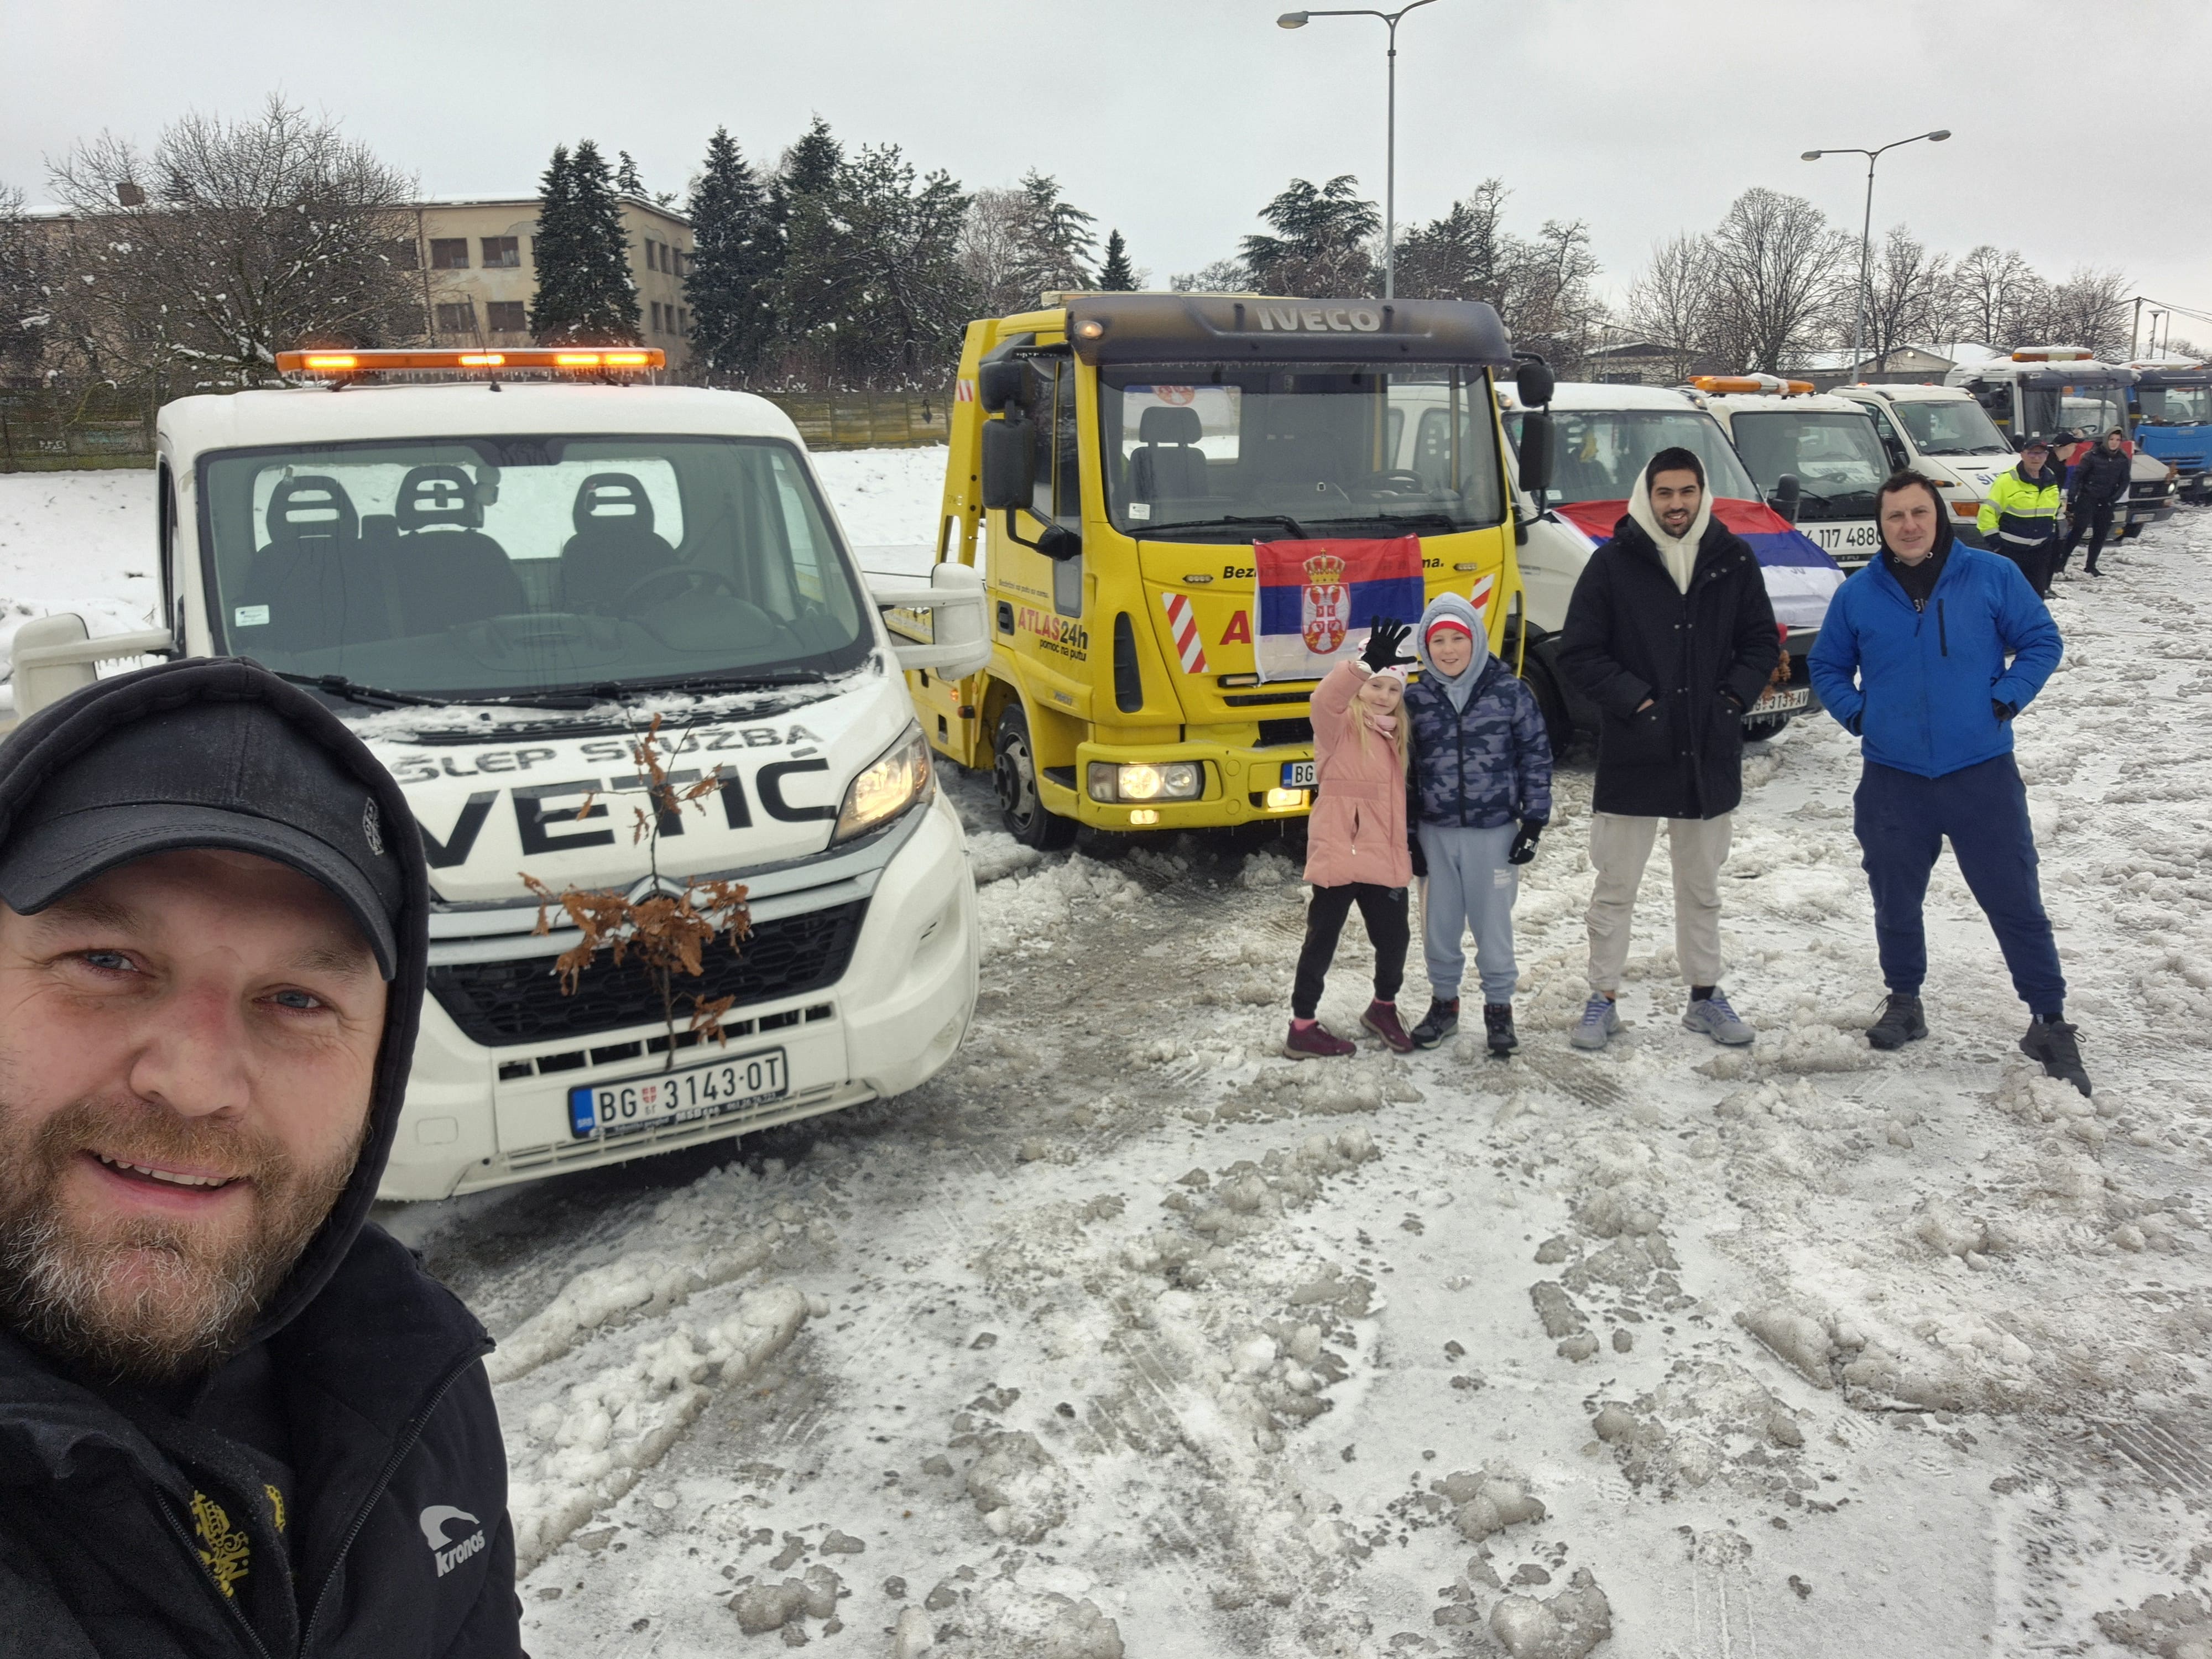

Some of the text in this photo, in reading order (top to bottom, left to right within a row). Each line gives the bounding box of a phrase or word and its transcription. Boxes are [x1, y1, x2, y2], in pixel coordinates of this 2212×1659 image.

[1256, 308, 1381, 331] IVECO
[1223, 566, 1256, 579] Bez
[390, 724, 825, 785] ŠLEP SLUŽBA
[1296, 765, 1313, 783] BG
[599, 1087, 637, 1123] BG
[435, 1529, 486, 1578] kronos
